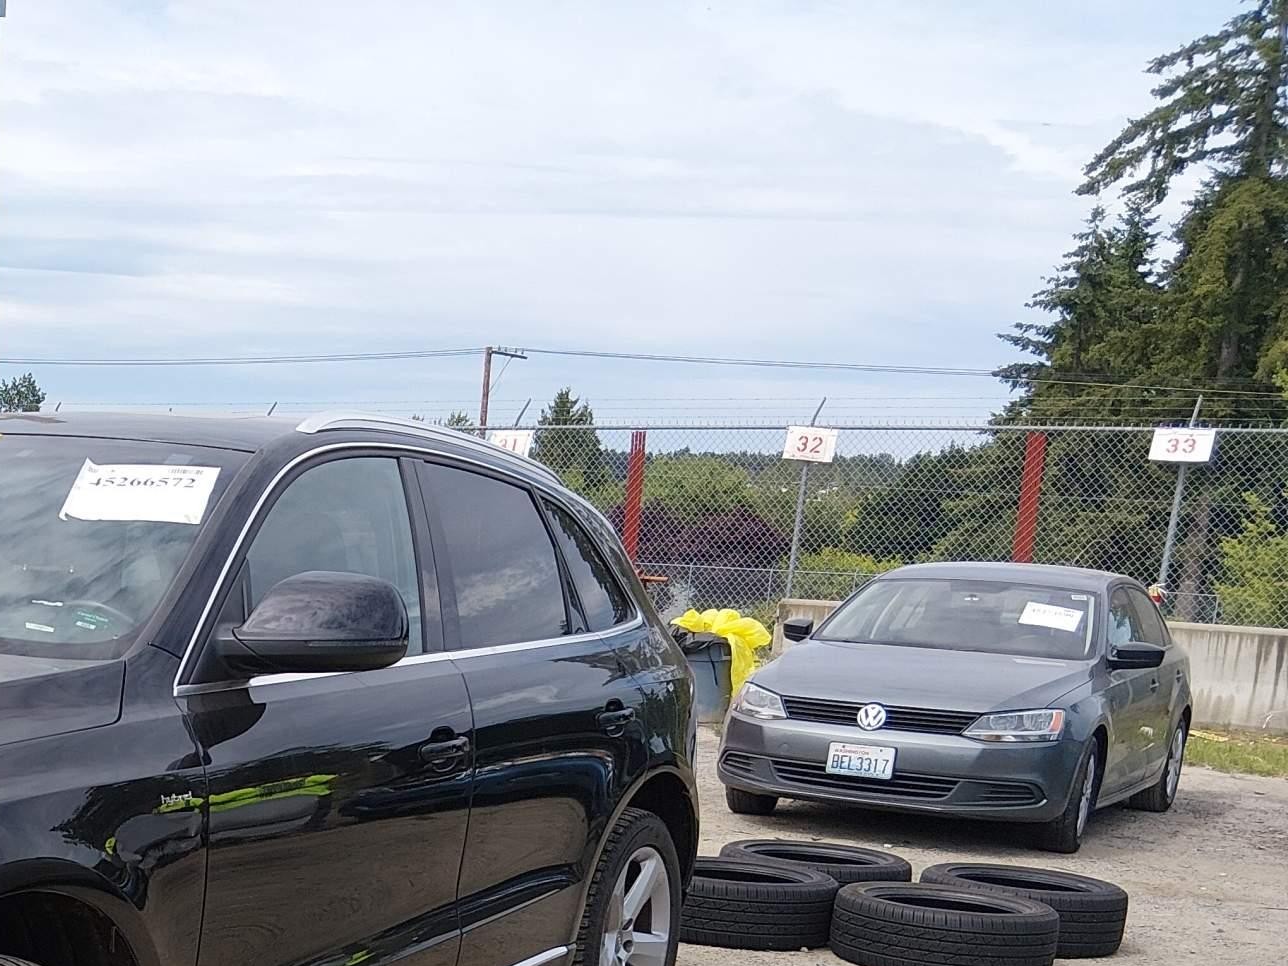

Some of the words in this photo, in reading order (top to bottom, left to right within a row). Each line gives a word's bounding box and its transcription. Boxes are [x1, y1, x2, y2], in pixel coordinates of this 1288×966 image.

[796, 435, 824, 453] 32
[1166, 438, 1196, 453] 33
[88, 477, 196, 488] 45266572
[830, 753, 890, 774] BEL3317
